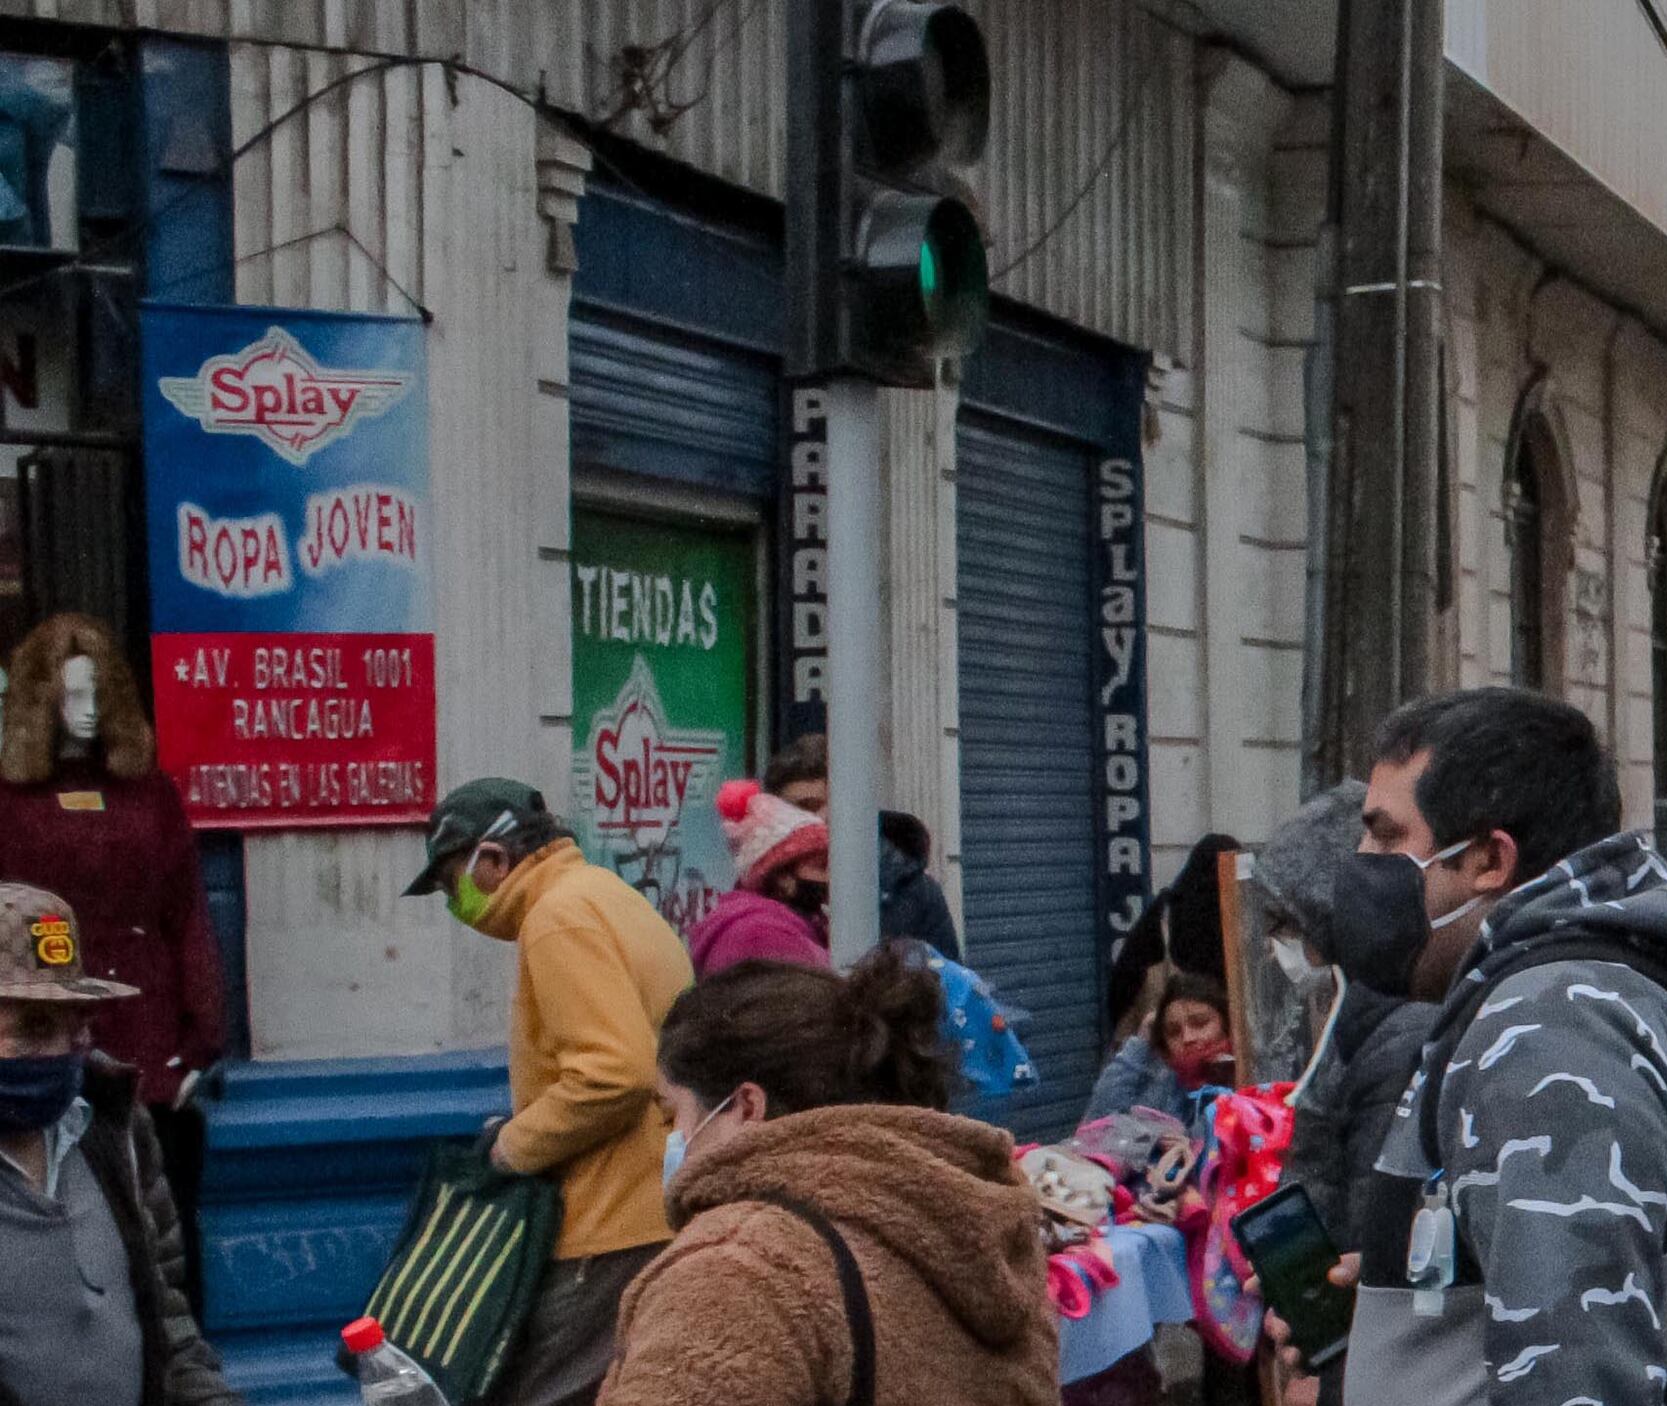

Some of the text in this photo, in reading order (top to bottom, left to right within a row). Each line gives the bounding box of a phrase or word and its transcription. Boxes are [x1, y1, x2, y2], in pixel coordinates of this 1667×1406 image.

[211, 367, 361, 427] Splay
[187, 492, 416, 589] ROPA JOVEN
[577, 565, 718, 651] TIENDAS
[254, 647, 349, 690] BRASIL
[363, 648, 412, 688] 1001
[232, 698, 374, 740] RANCAGUA
[595, 728, 693, 828] Splay
[1105, 714, 1142, 876] ROPA
